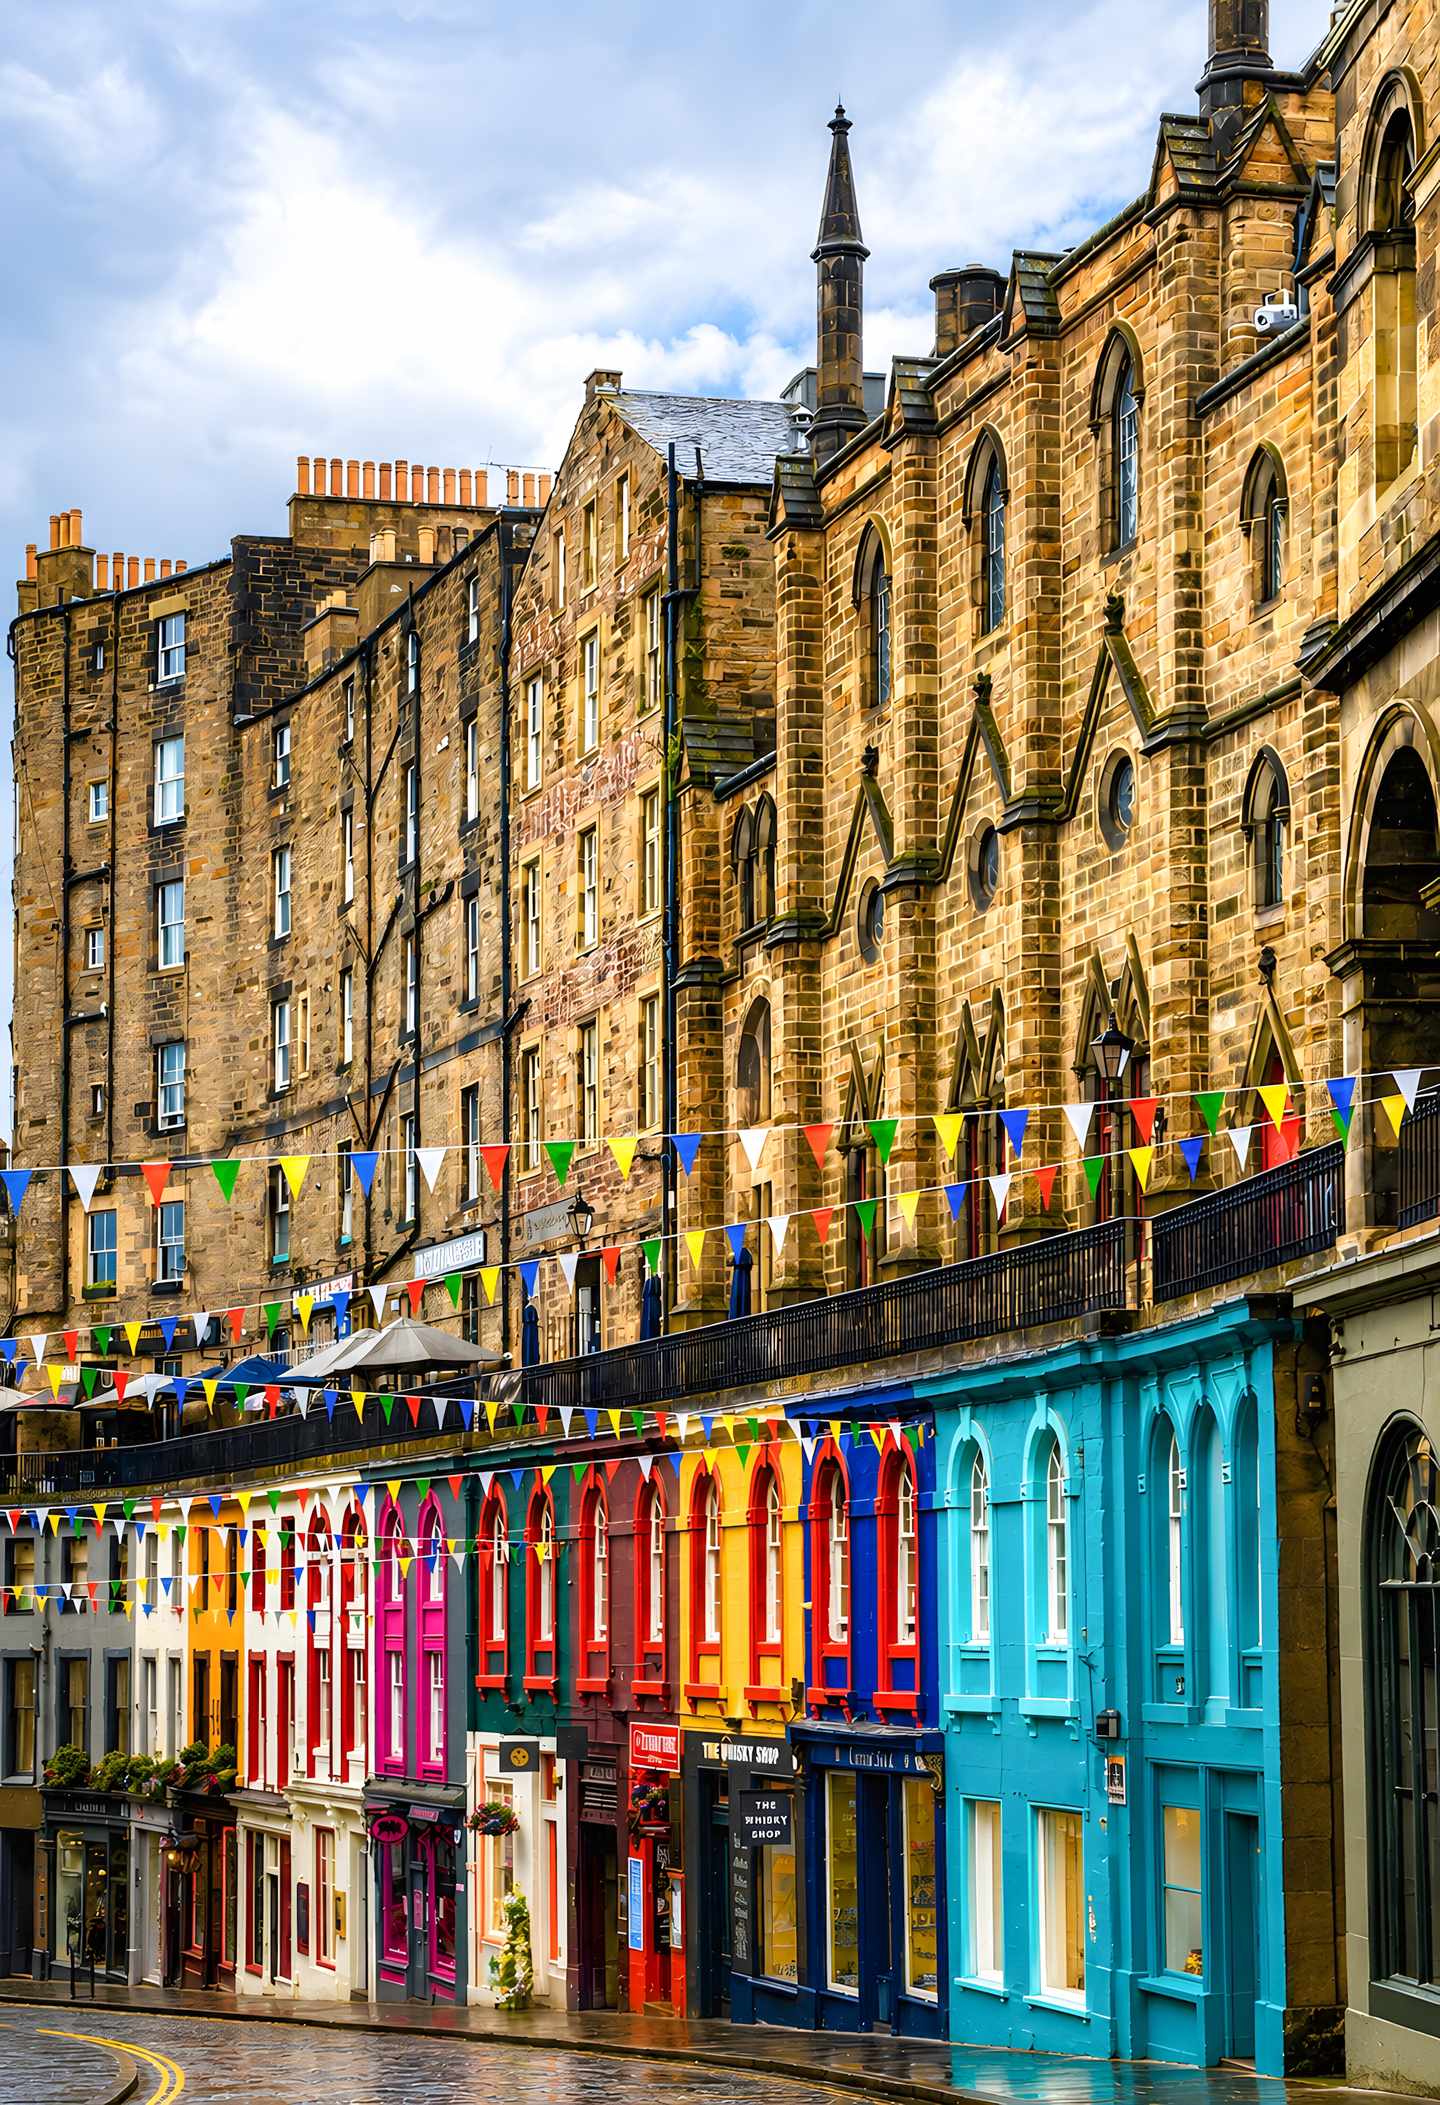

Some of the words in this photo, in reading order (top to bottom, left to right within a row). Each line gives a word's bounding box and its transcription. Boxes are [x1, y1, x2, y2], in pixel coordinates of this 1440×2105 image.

[702, 1742, 720, 1760] THE
[755, 1746, 779, 1765] SHOP
[755, 1801, 776, 1810] THE
